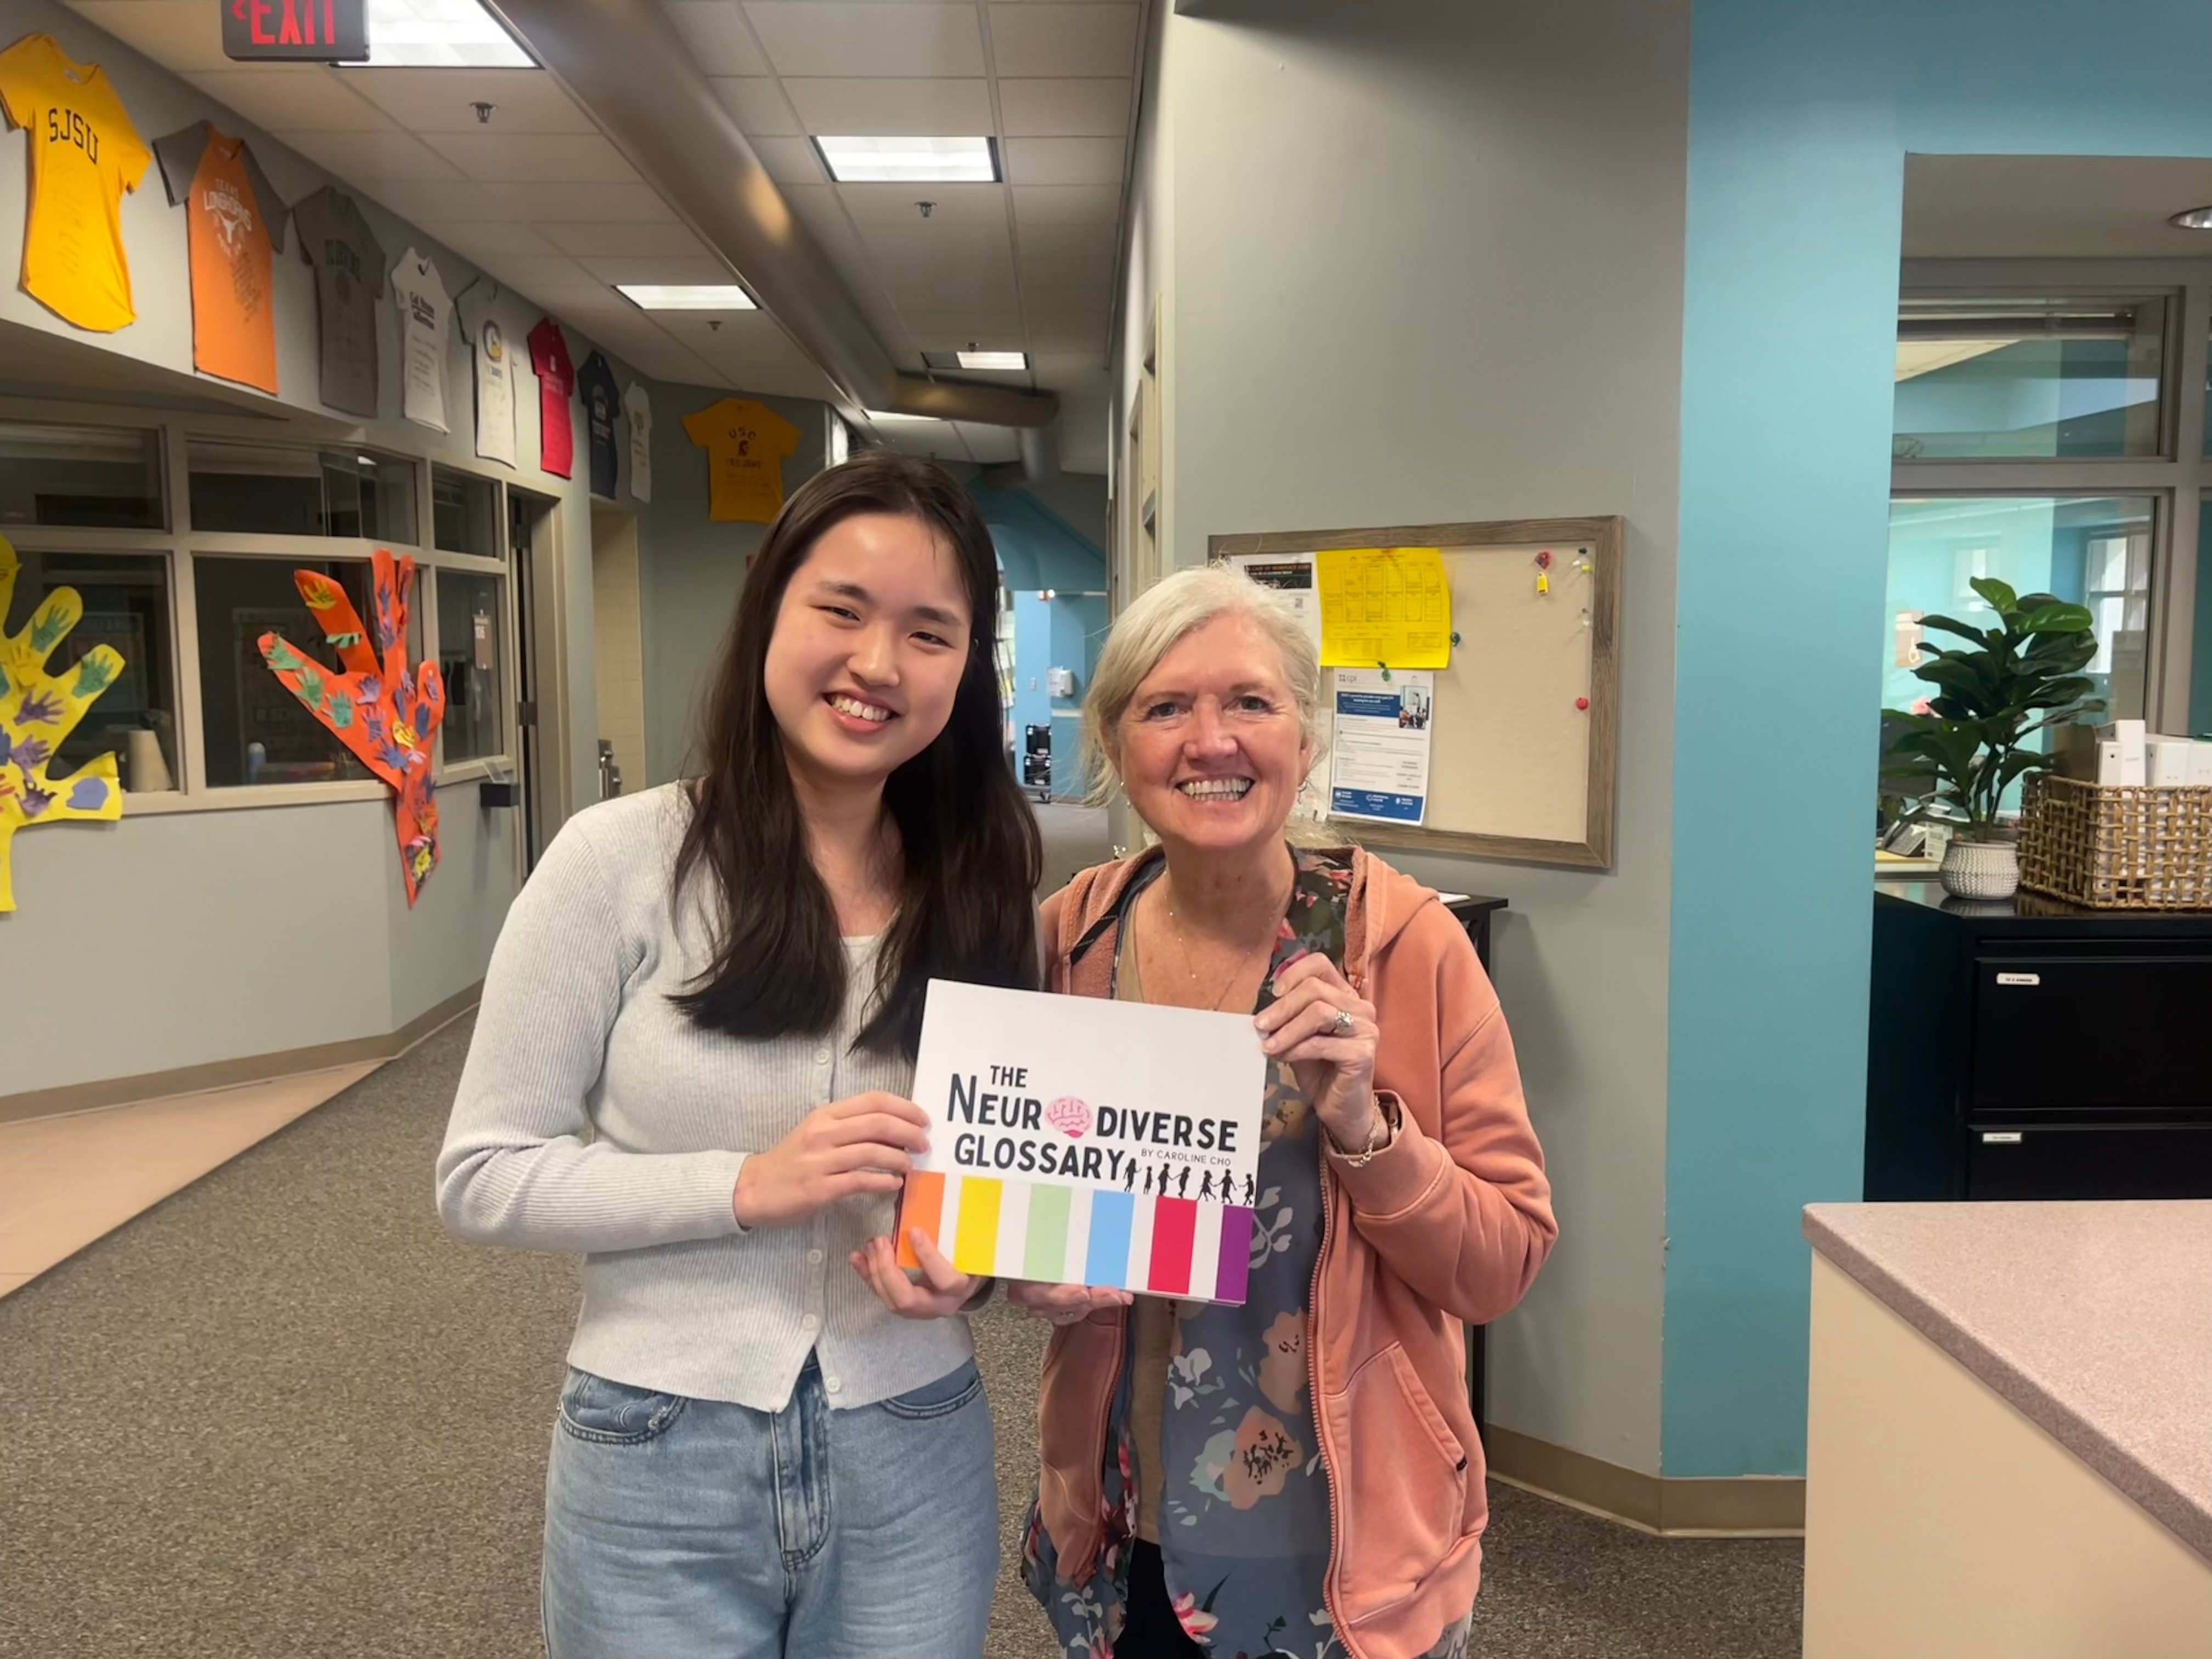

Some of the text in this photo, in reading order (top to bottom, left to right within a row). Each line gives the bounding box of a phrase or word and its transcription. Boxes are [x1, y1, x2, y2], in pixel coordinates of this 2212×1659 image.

[251, 0, 335, 44] EXIT
[48, 108, 99, 165] SJSU
[729, 426, 756, 441] USC
[990, 1065, 1028, 1088] THE
[947, 1073, 1238, 1153] NEUR DIVERSE
[955, 1133, 1125, 1181] GLOSSARY
[1141, 1148, 1231, 1166] BY CAROLINE CHO
